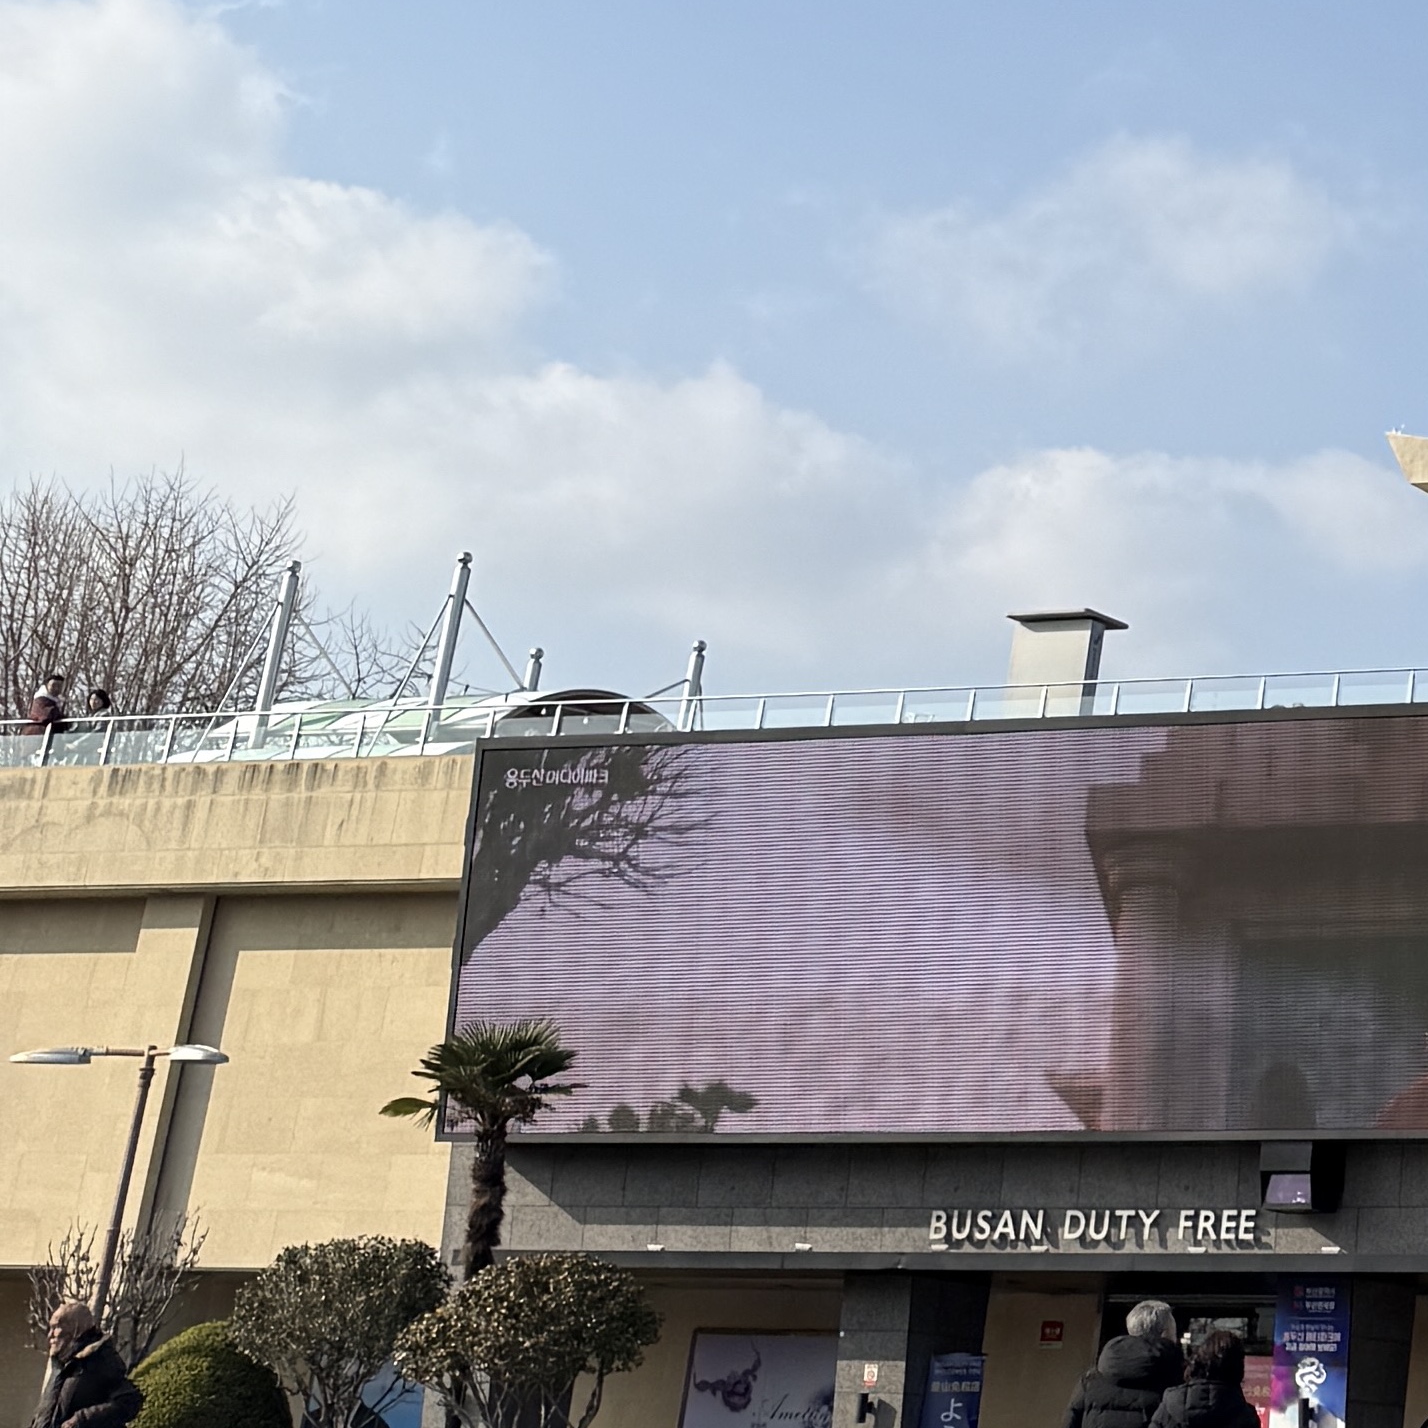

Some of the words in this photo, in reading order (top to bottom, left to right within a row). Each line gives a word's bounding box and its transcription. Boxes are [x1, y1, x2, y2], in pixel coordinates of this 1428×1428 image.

[929, 1209, 1045, 1241] BUSAN
[1063, 1209, 1161, 1241] DUTY
[1177, 1209, 1257, 1241] FREE
